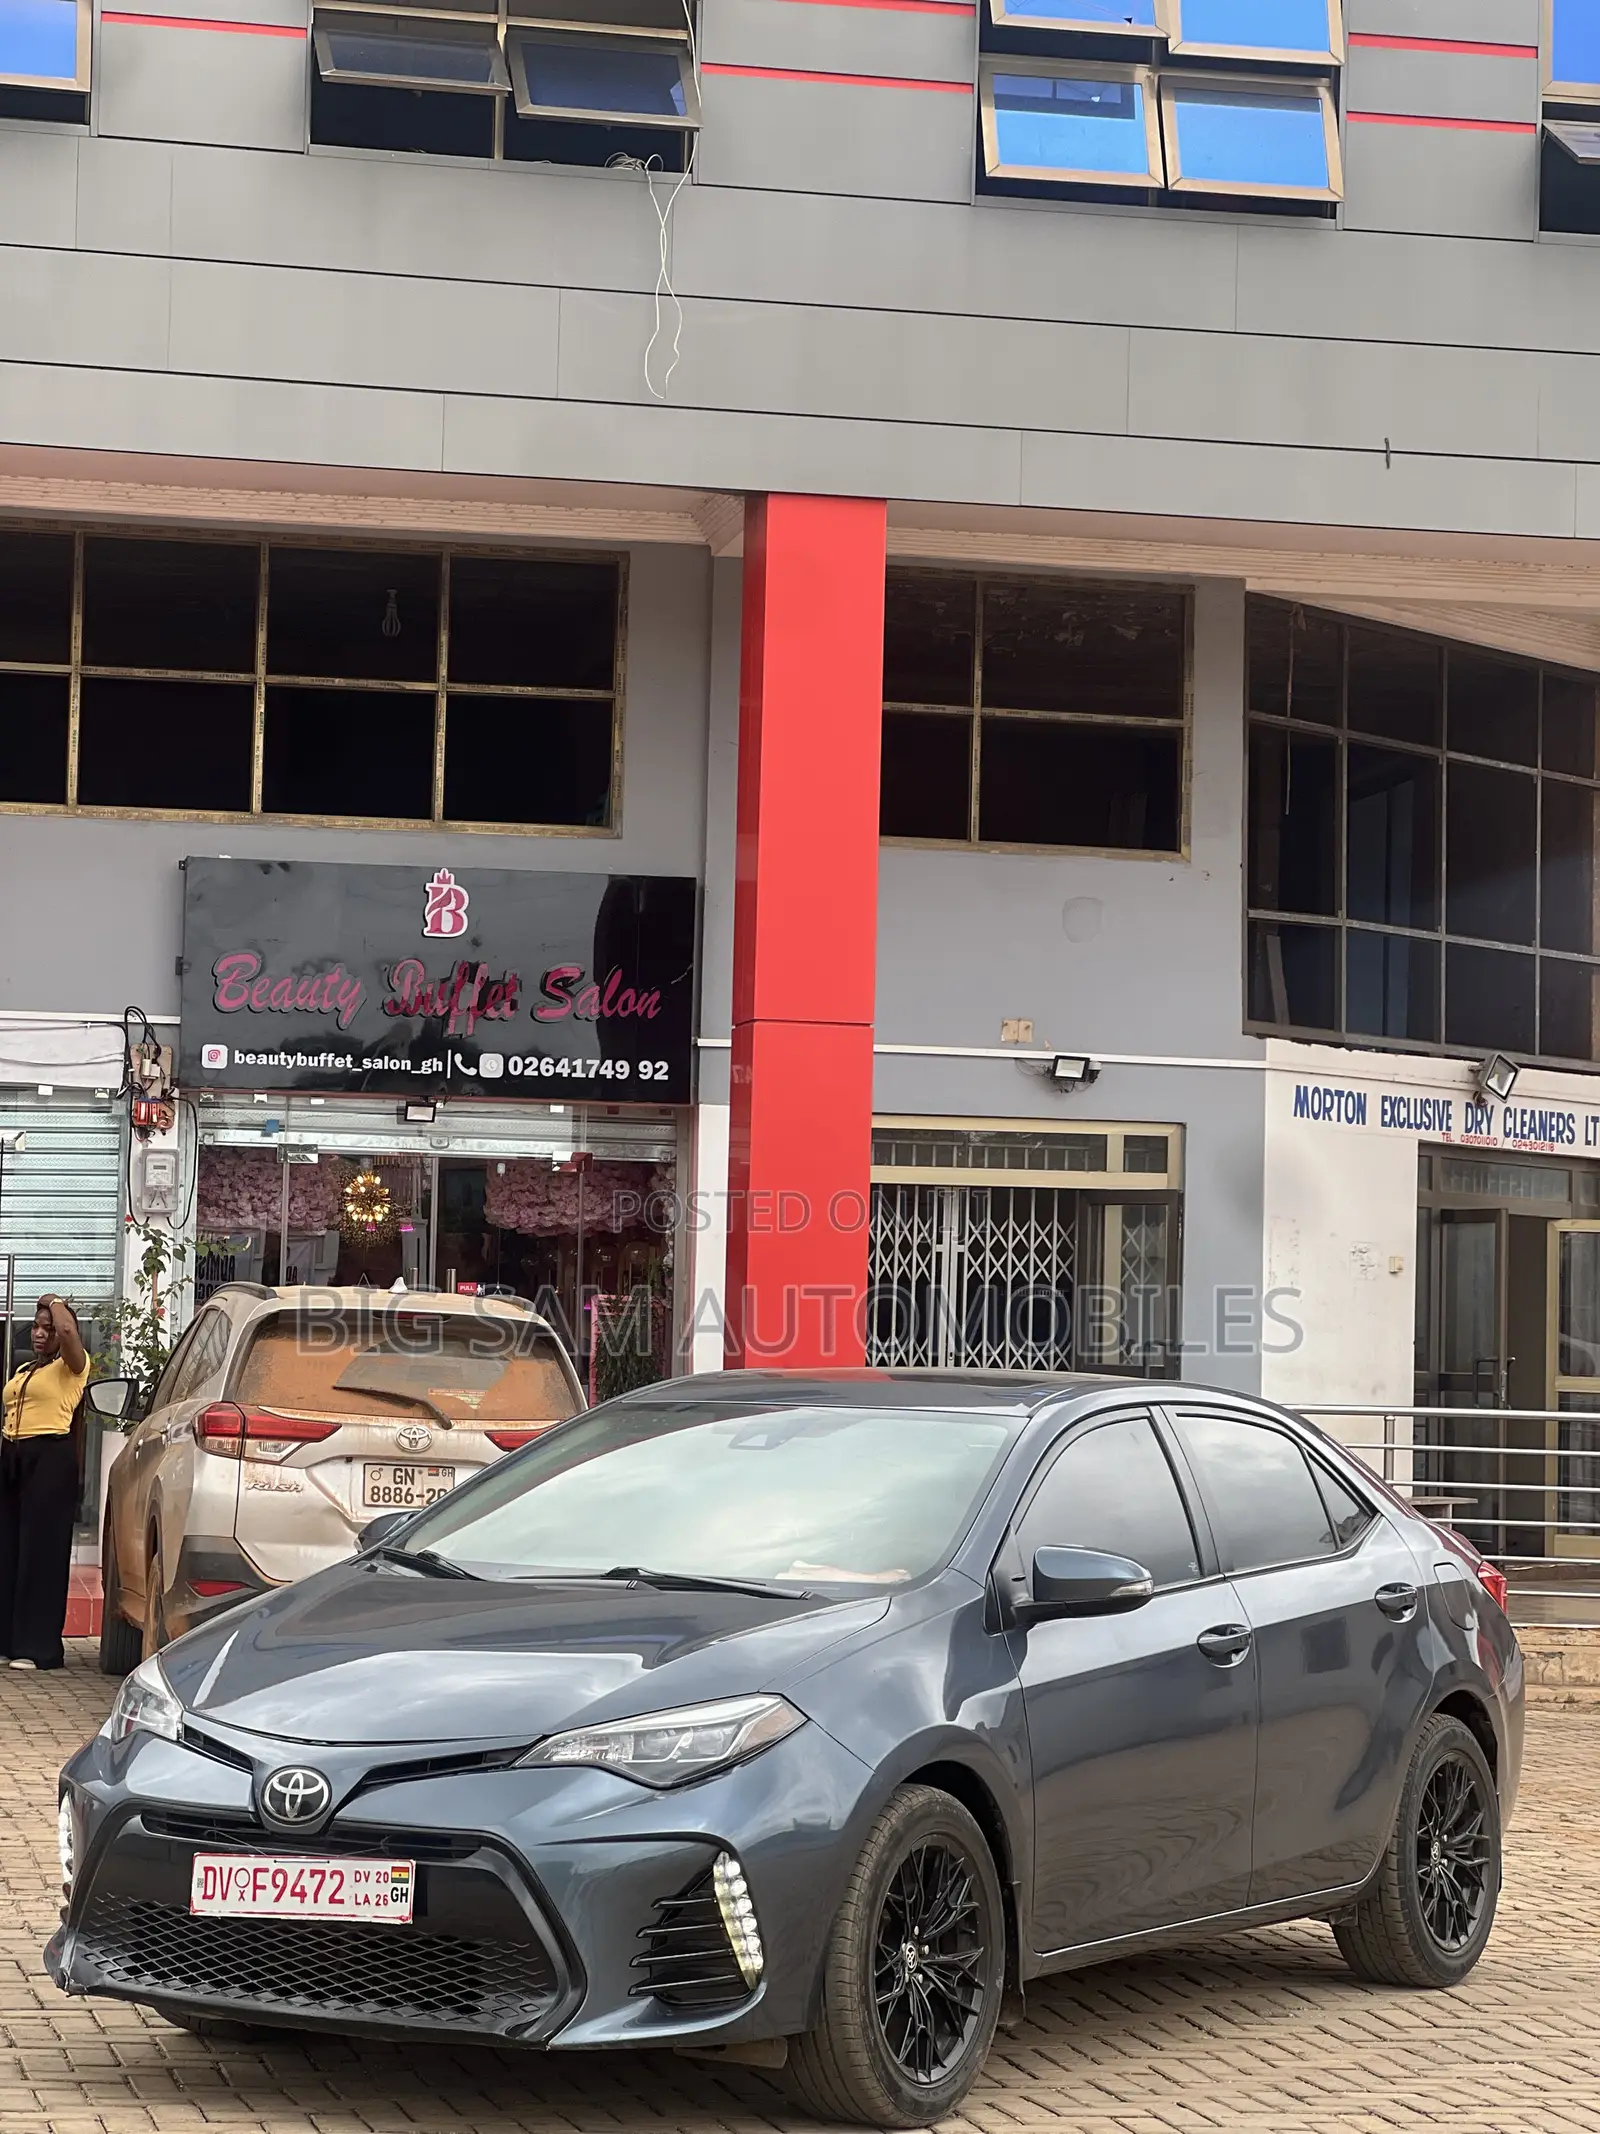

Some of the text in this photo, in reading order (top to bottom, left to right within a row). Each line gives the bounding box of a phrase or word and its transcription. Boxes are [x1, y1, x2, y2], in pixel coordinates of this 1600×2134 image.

[214, 951, 662, 1038] Beauty Buffet Salon
[234, 1050, 443, 1074] beautybuffet_salon_gh
[1293, 1084, 1367, 1126] MORTON
[1381, 1095, 1453, 1132] EXCLUSIVE
[1464, 1101, 1495, 1135] DRY
[1503, 1106, 1576, 1146] CLEANERS
[393, 1467, 453, 1485] GN GH
[202, 1866, 345, 1905] DV F9472
[354, 1870, 389, 1884] DV 20
[354, 1893, 389, 1907] LA 26
[390, 1886, 409, 1903] GH
